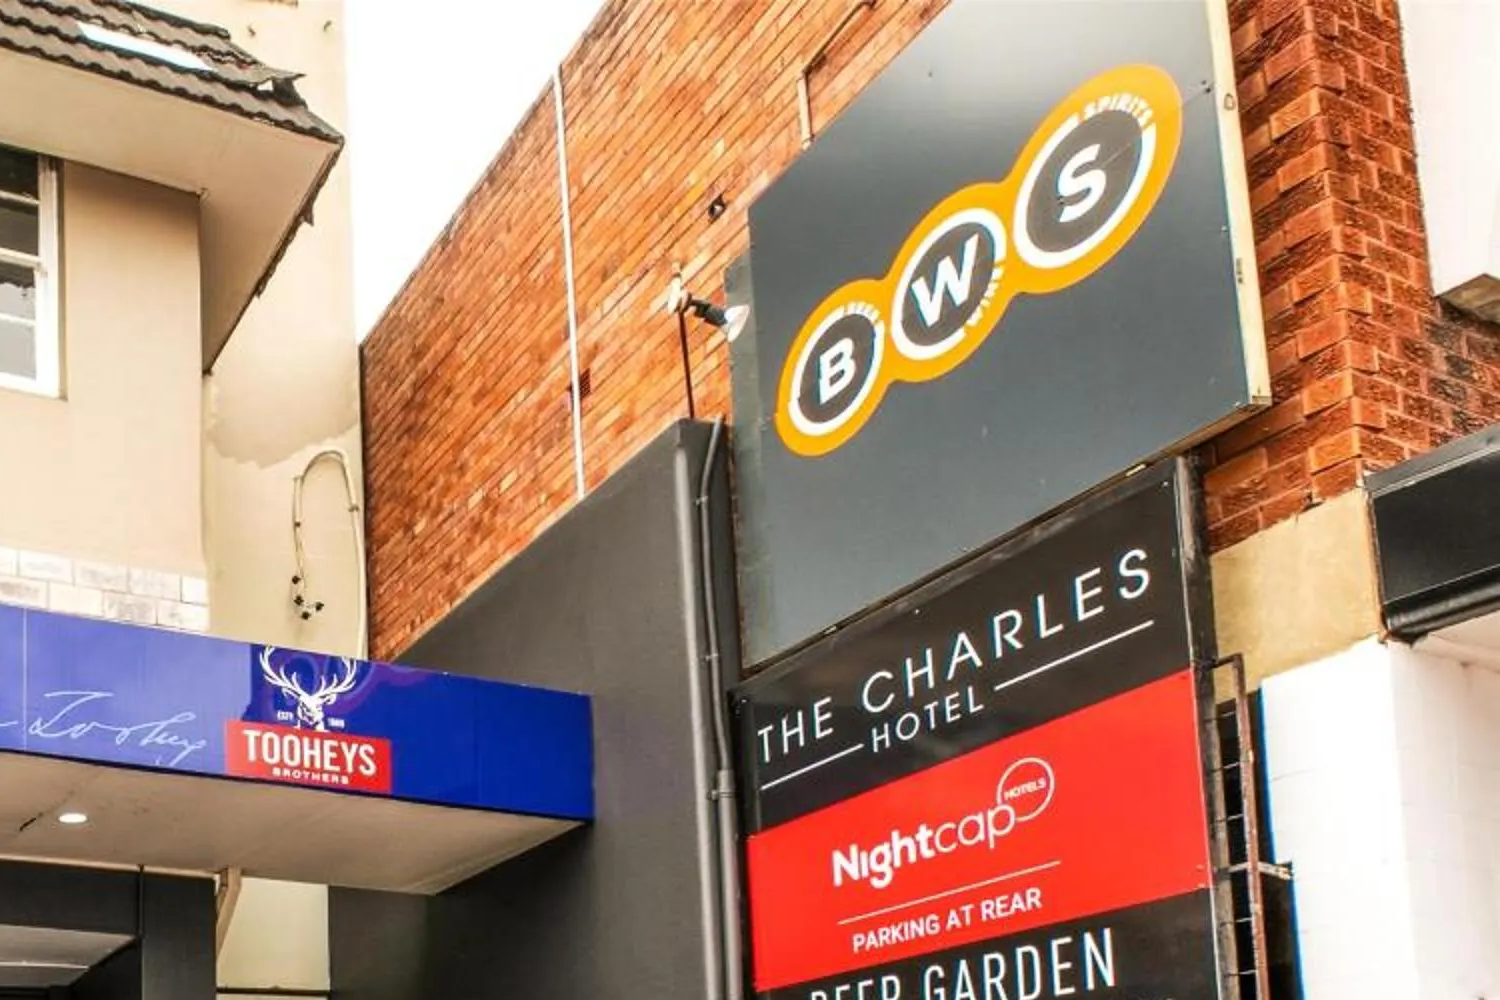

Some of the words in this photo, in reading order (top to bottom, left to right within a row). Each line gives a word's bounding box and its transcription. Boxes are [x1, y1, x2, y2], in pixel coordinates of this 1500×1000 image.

[757, 697, 834, 763] THE
[862, 548, 1152, 714] CHARLES
[871, 686, 985, 753] HOTEL
[242, 729, 378, 777] TOOHEYS
[271, 767, 349, 785] BROTHERS
[1004, 777, 1047, 801] HOTELS
[831, 802, 1015, 889] Nightcap
[852, 915, 940, 953] PARKING
[946, 904, 974, 932] AT
[980, 887, 1042, 924] REAR
